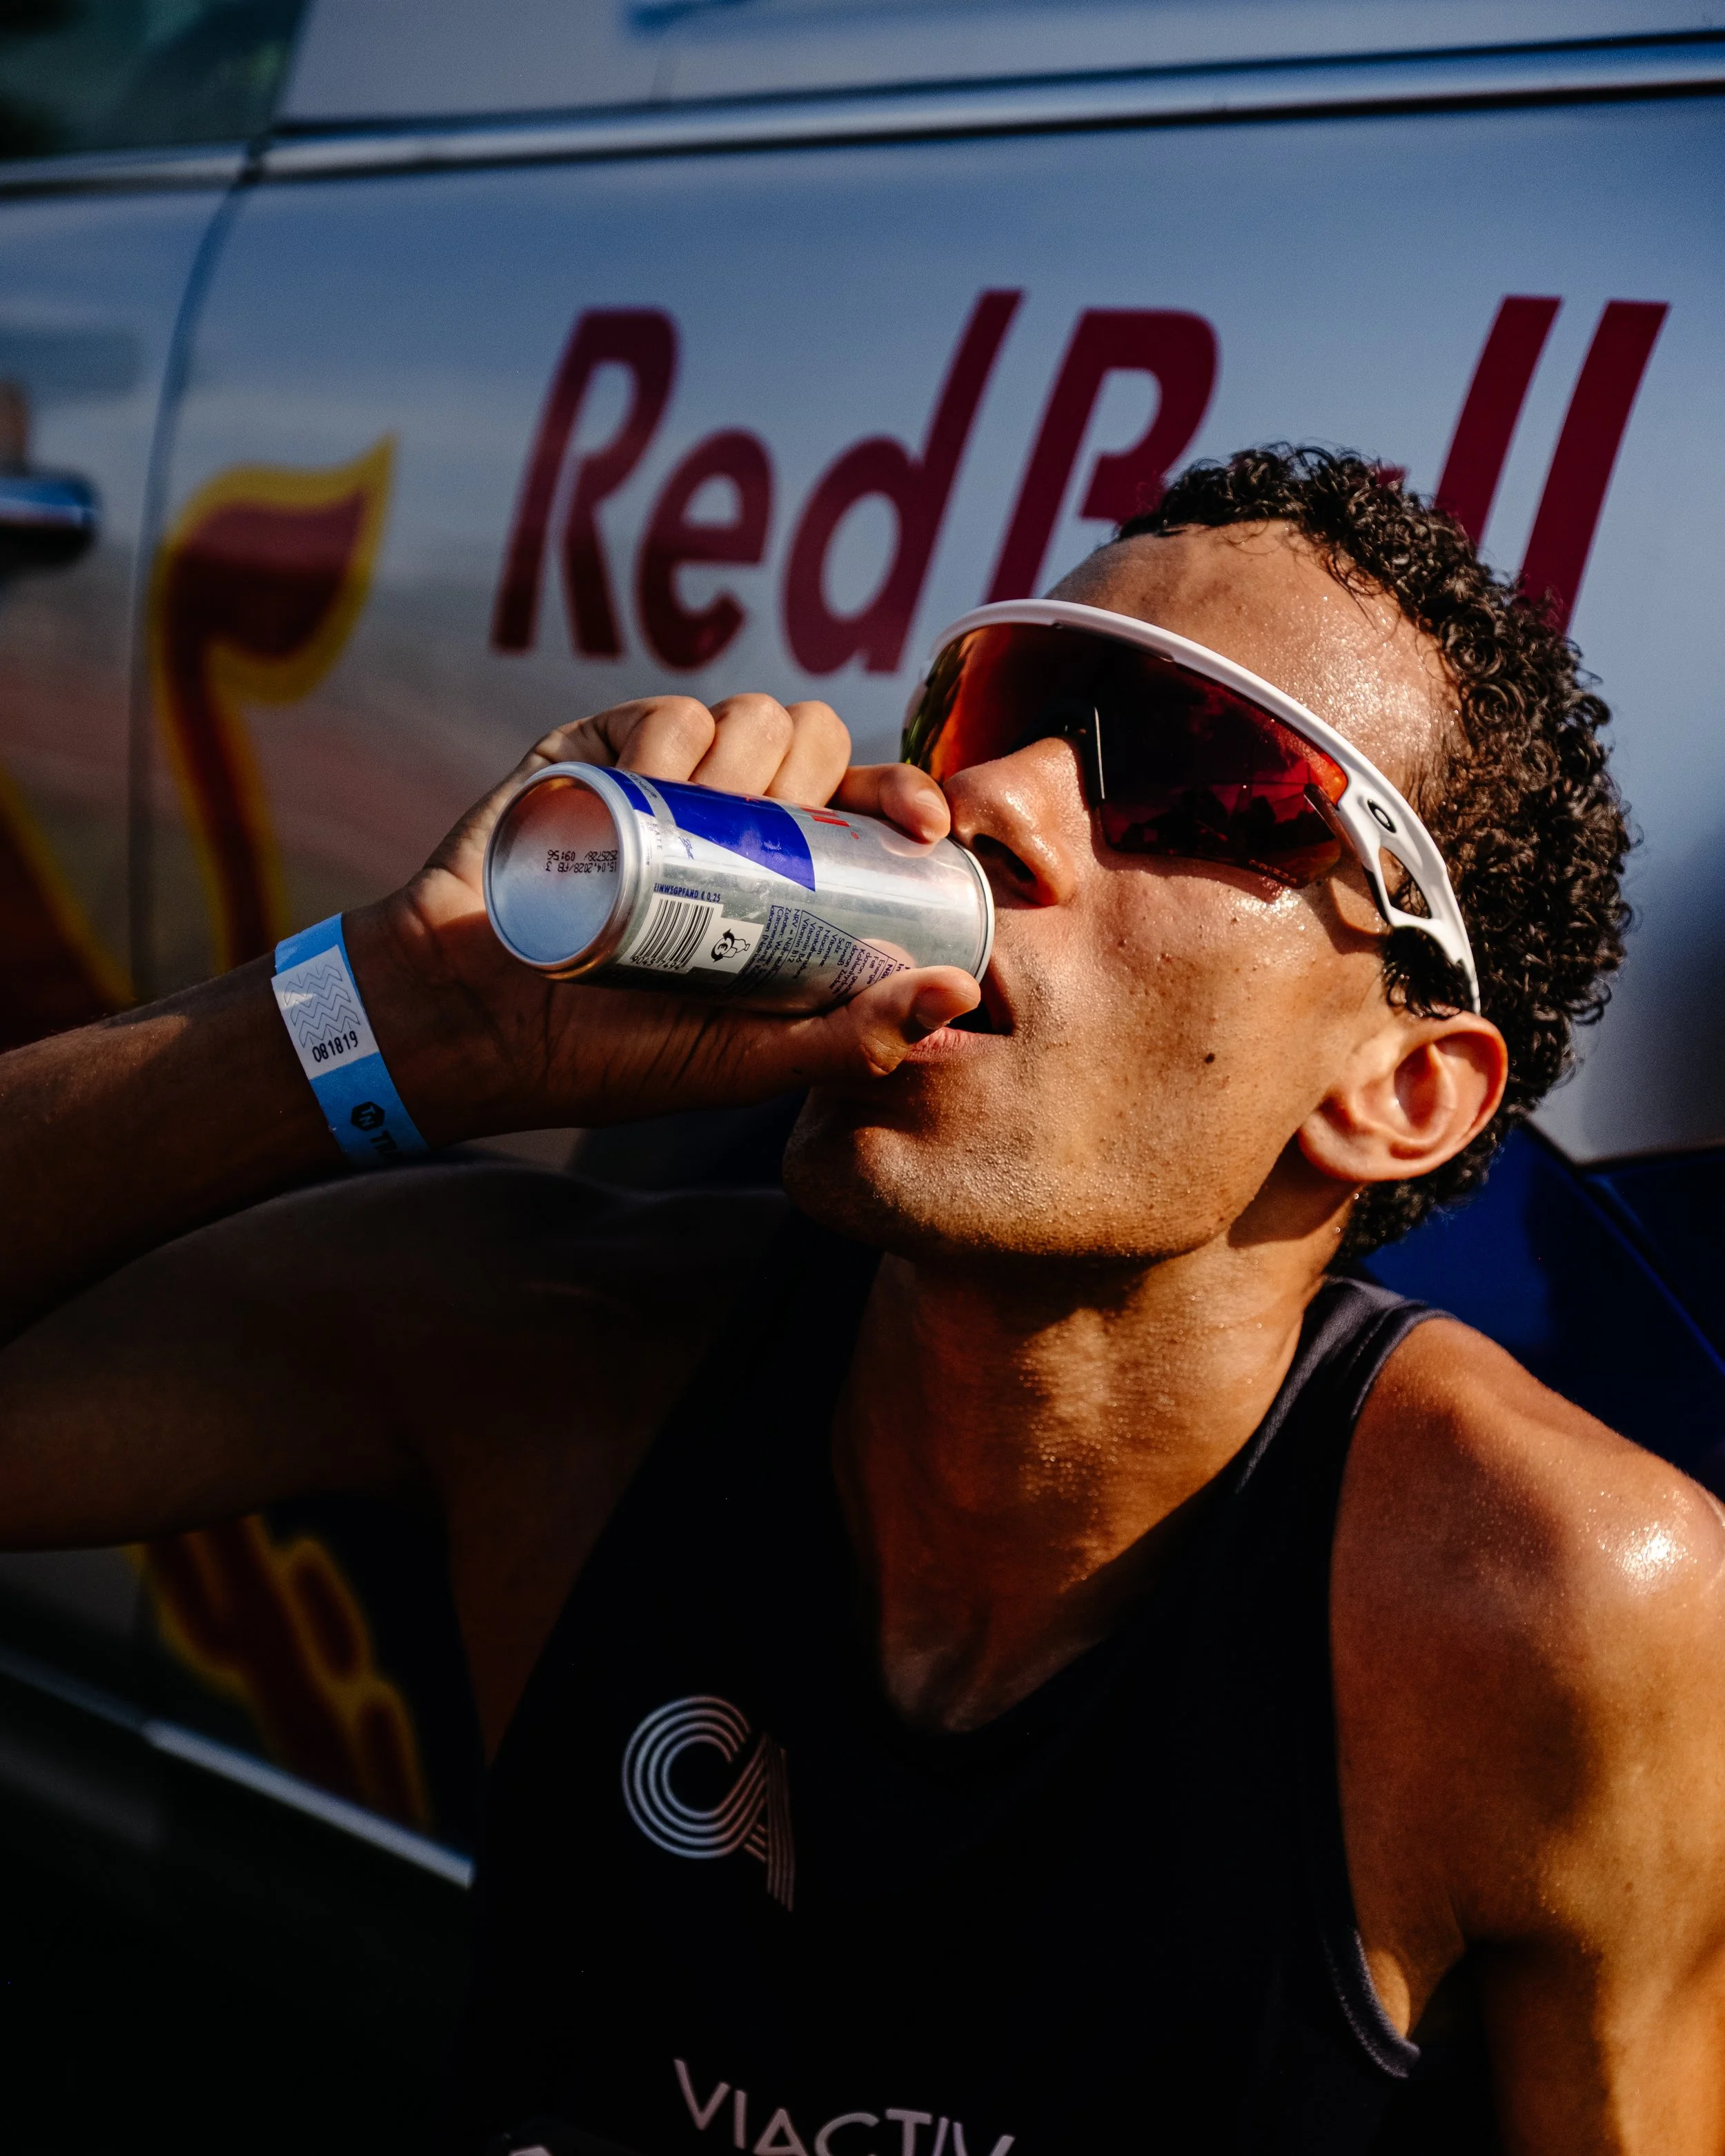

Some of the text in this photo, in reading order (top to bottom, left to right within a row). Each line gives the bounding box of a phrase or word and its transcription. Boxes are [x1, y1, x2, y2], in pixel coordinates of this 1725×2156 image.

[491, 290, 1670, 677] Red Bll
[653, 883, 699, 898] EINWEGPFAND
[779, 907, 792, 938] Zutaten:
[791, 909, 801, 928] NRV
[787, 918, 809, 963] Vitamin B12
[796, 922, 817, 963] Vitamin B6
[816, 929, 831, 955] Niacin
[834, 938, 845, 954] Salz
[837, 941, 852, 966] Eiweiß
[844, 945, 858, 967] davon
[857, 952, 872, 974] davon
[869, 956, 879, 969] Fett
[867, 959, 885, 985] Energie
[311, 1030, 359, 1063] 081819
